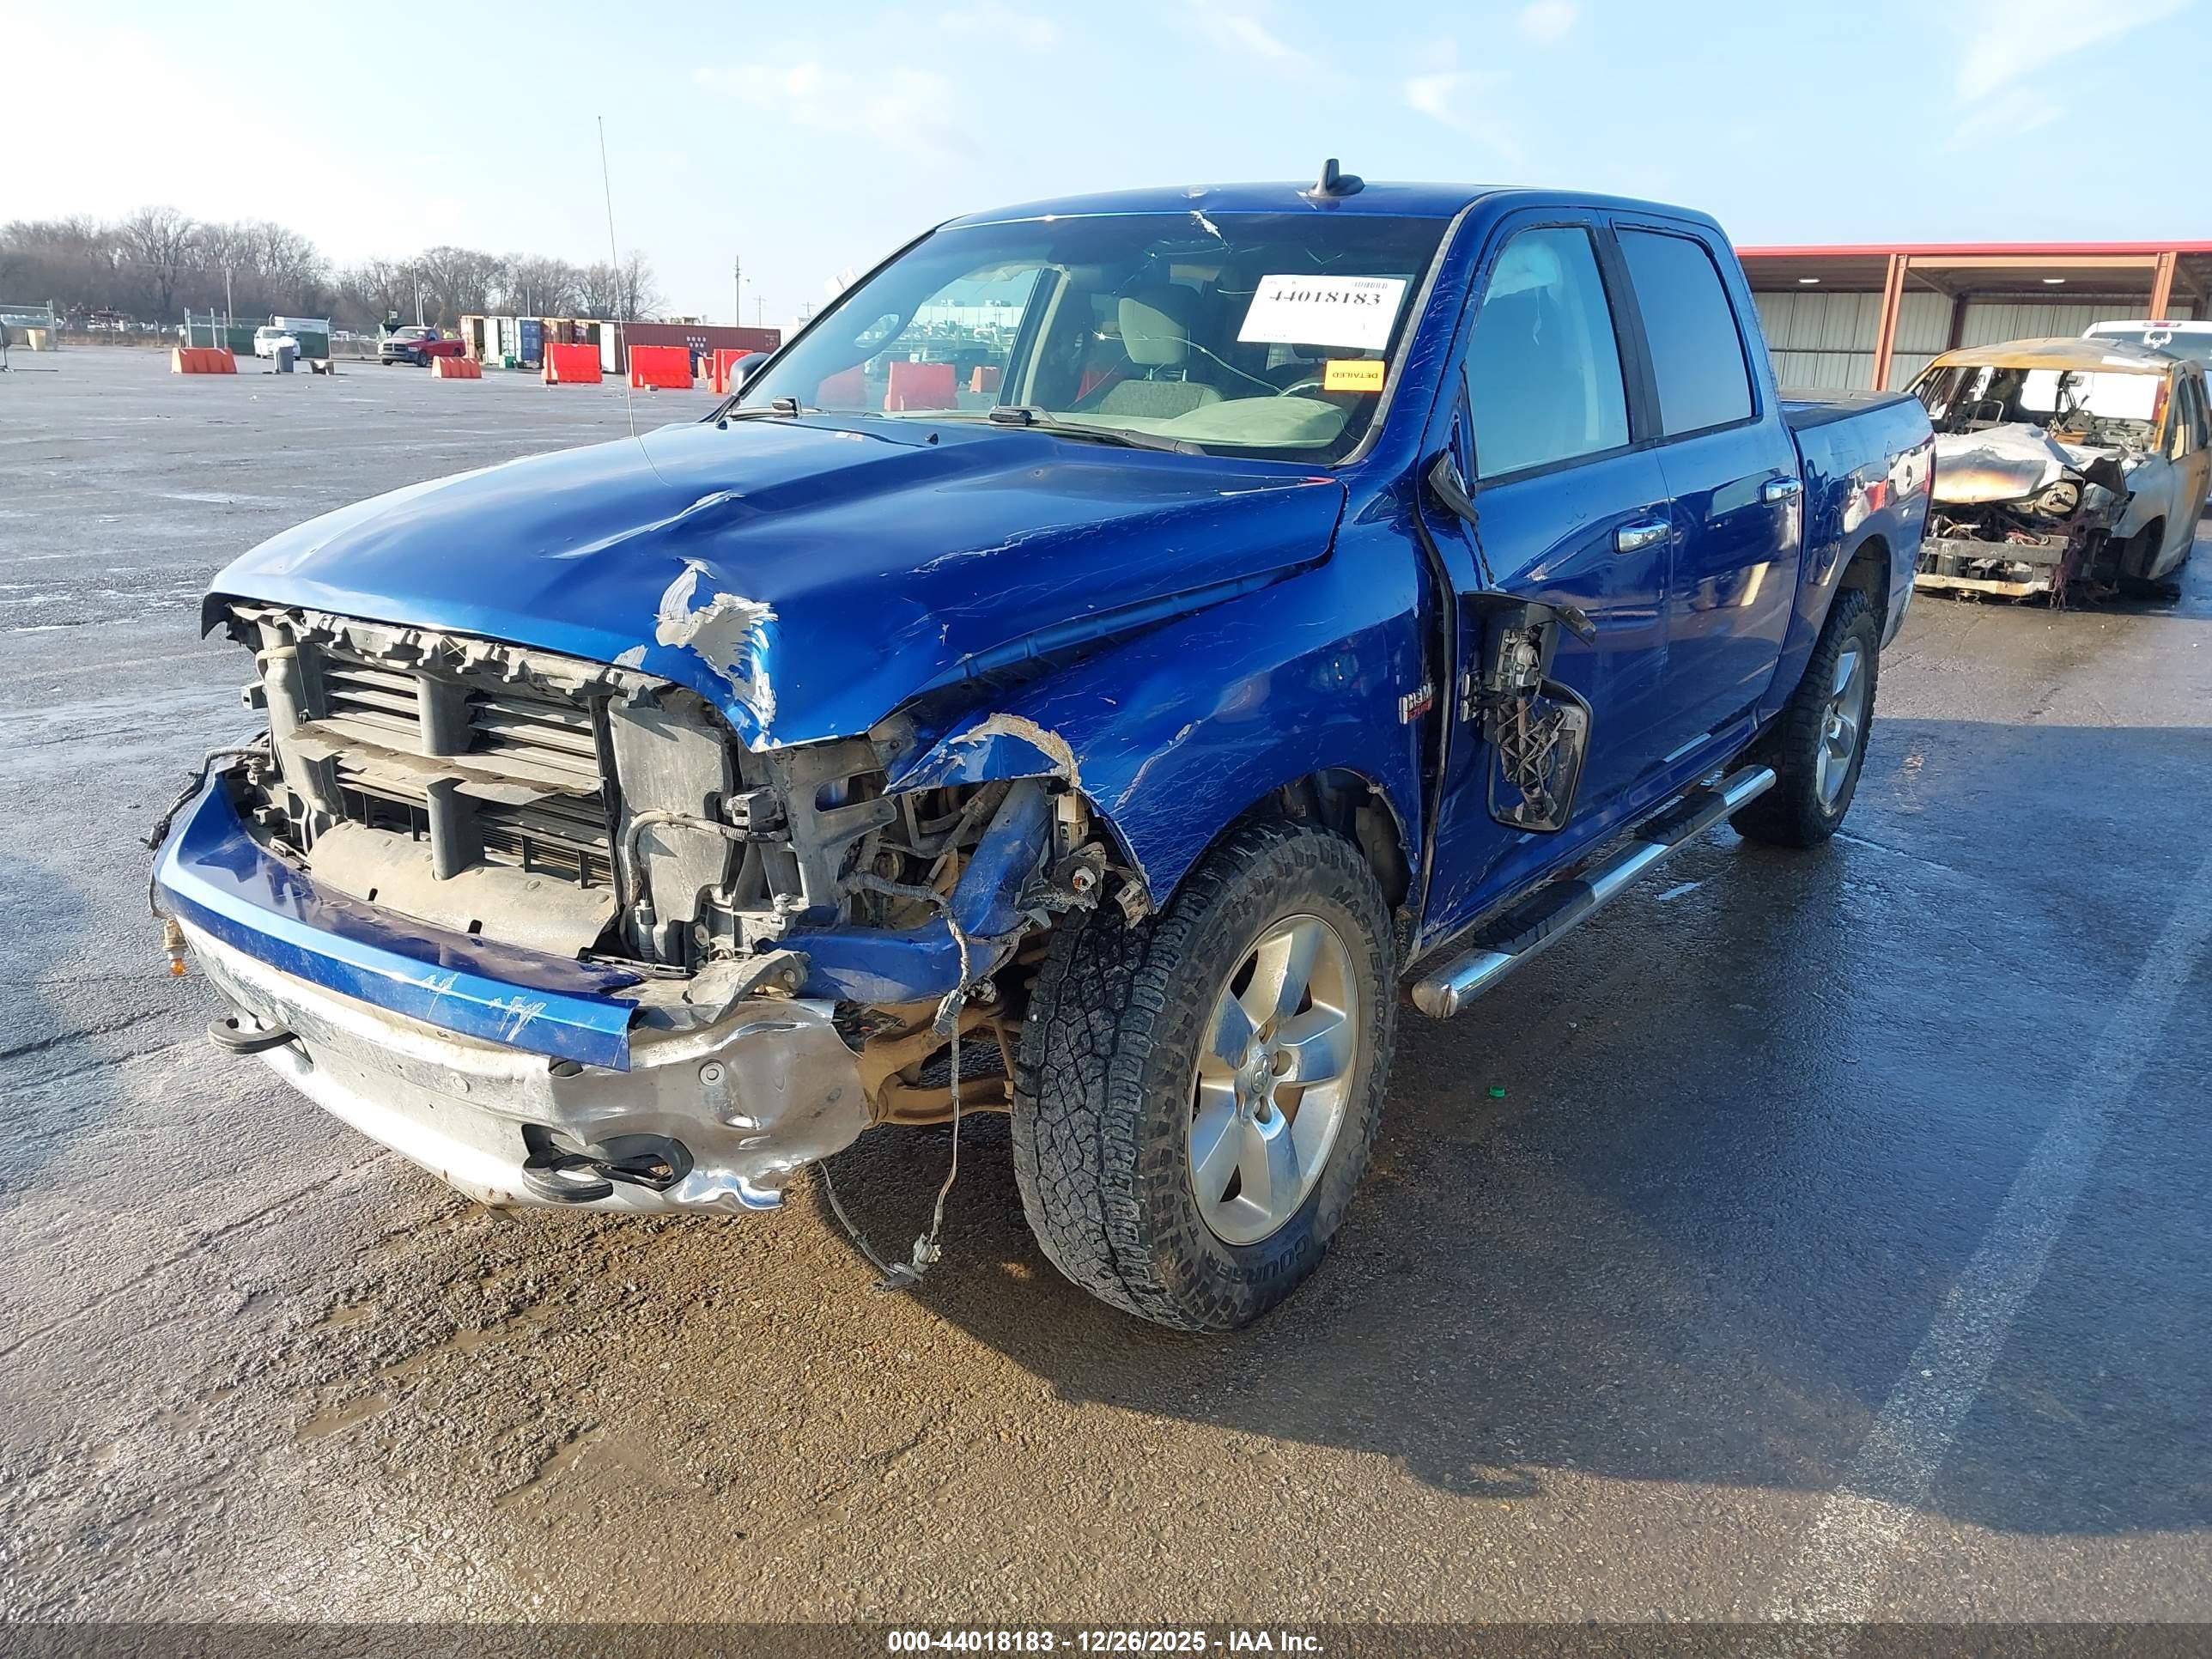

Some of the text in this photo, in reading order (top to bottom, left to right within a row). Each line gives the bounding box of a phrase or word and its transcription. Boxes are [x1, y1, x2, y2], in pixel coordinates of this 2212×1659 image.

[1269, 289, 1381, 306] 44018183
[1332, 371, 1379, 380] DETAILED
[1332, 885, 1388, 1144] MASTERCRAFT
[1206, 1234, 1310, 1287] COURSER
